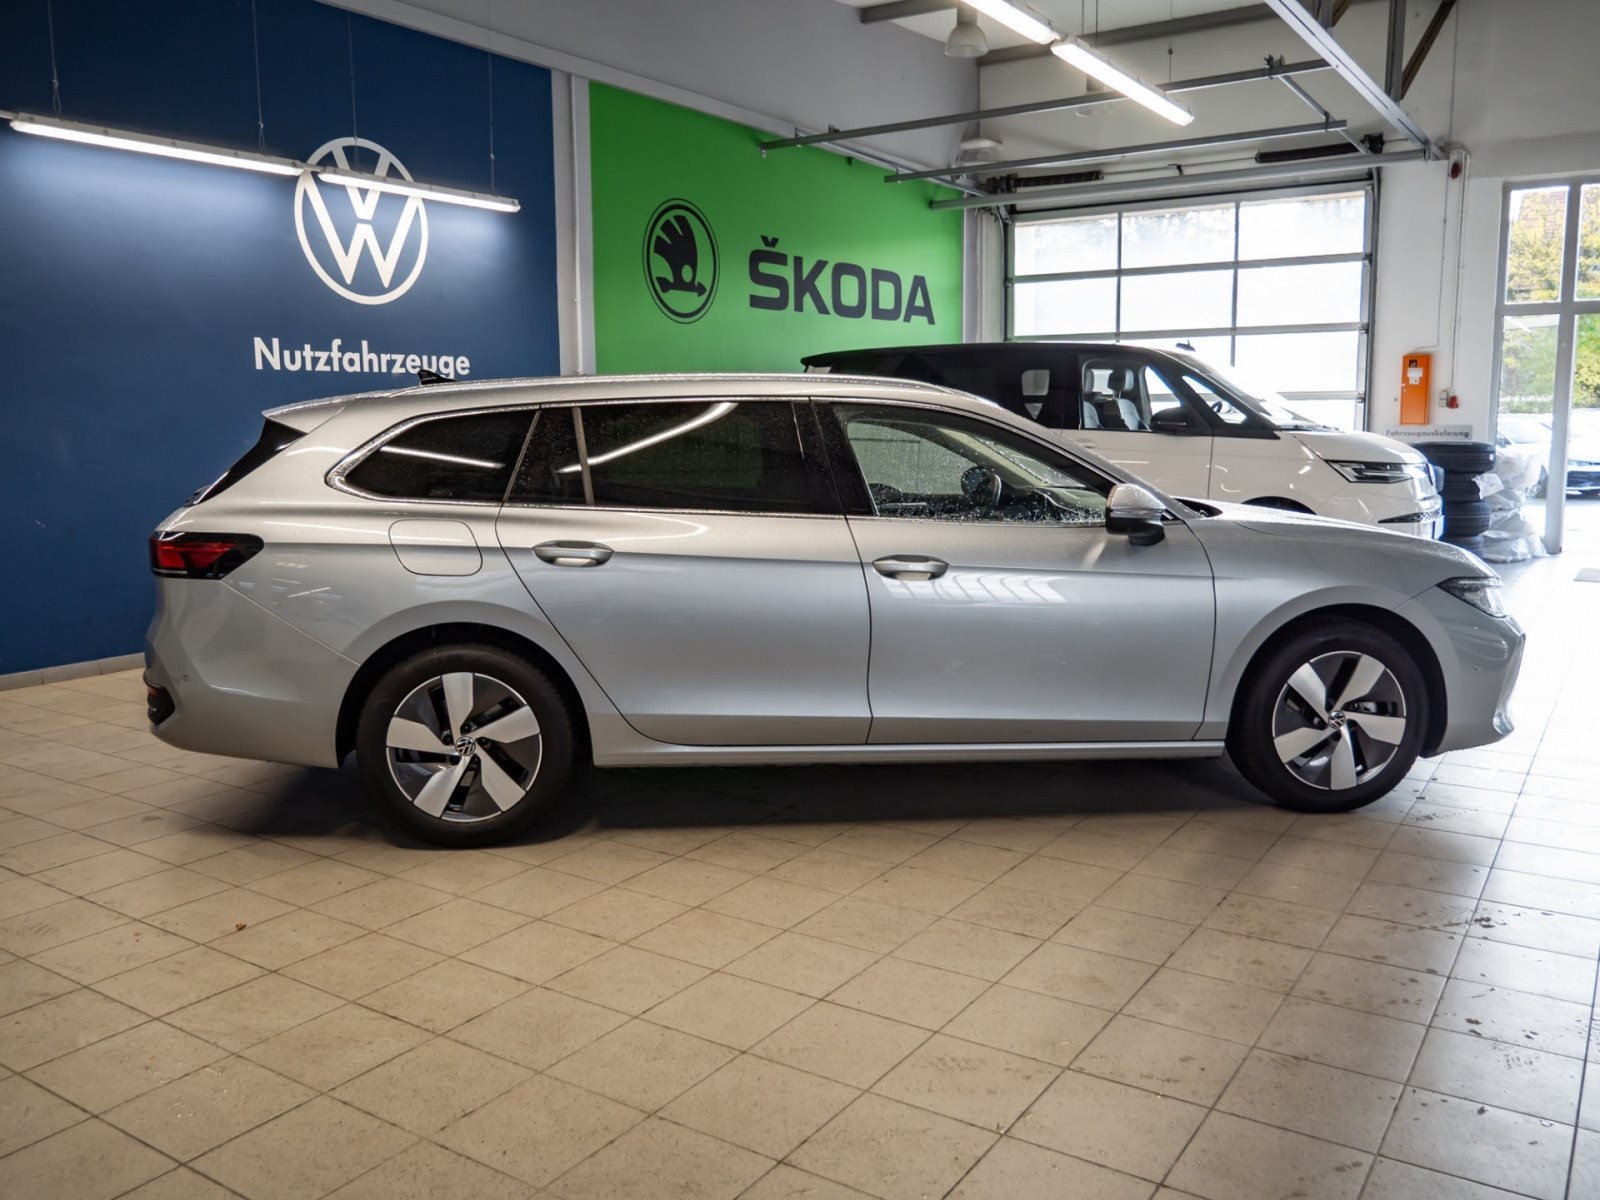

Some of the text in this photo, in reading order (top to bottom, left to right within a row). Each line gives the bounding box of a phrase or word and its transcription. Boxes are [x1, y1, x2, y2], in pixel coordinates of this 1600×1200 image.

[749, 235, 935, 325] ŠKODA
[253, 336, 470, 379] Nutzfahrzeuge
[1386, 429, 1470, 438] Fahrzeugauslieferung
